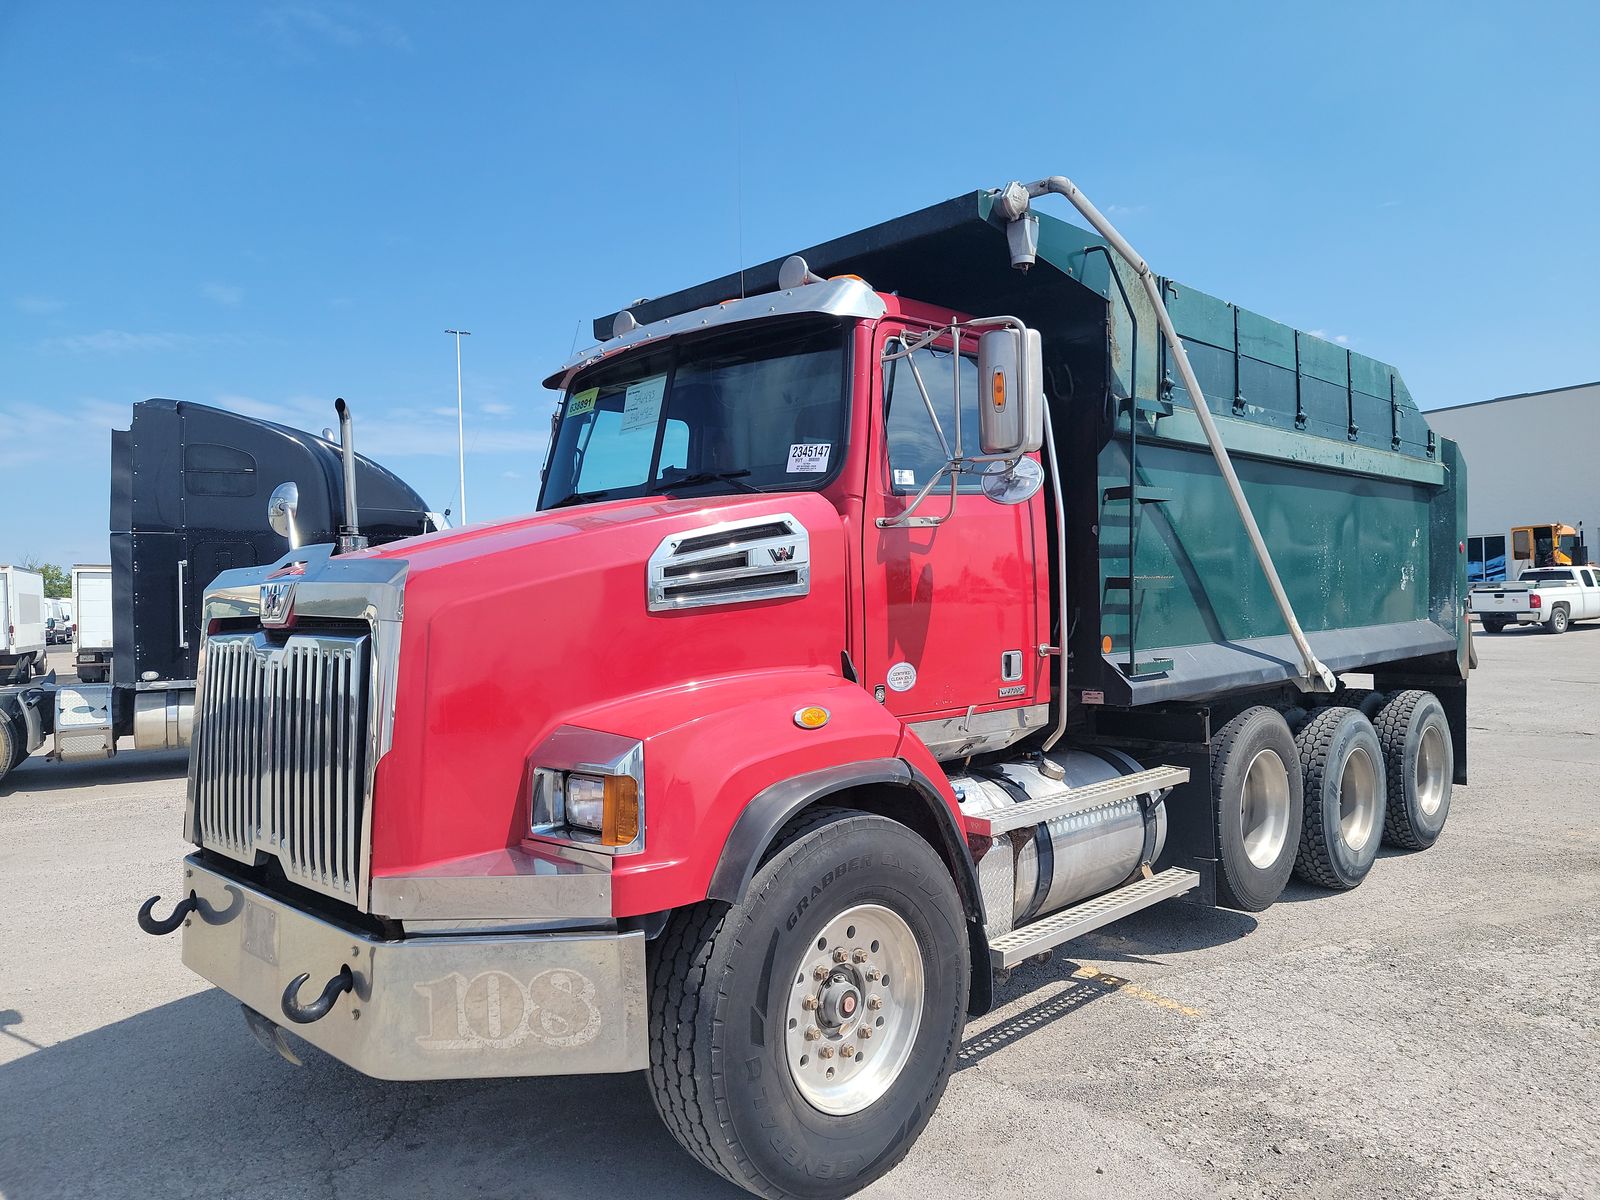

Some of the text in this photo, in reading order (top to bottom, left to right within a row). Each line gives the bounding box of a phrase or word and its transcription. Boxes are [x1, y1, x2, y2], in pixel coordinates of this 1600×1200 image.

[792, 445, 830, 459] 2345147
[786, 855, 872, 932] GRABBER
[413, 967, 603, 1051] 108
